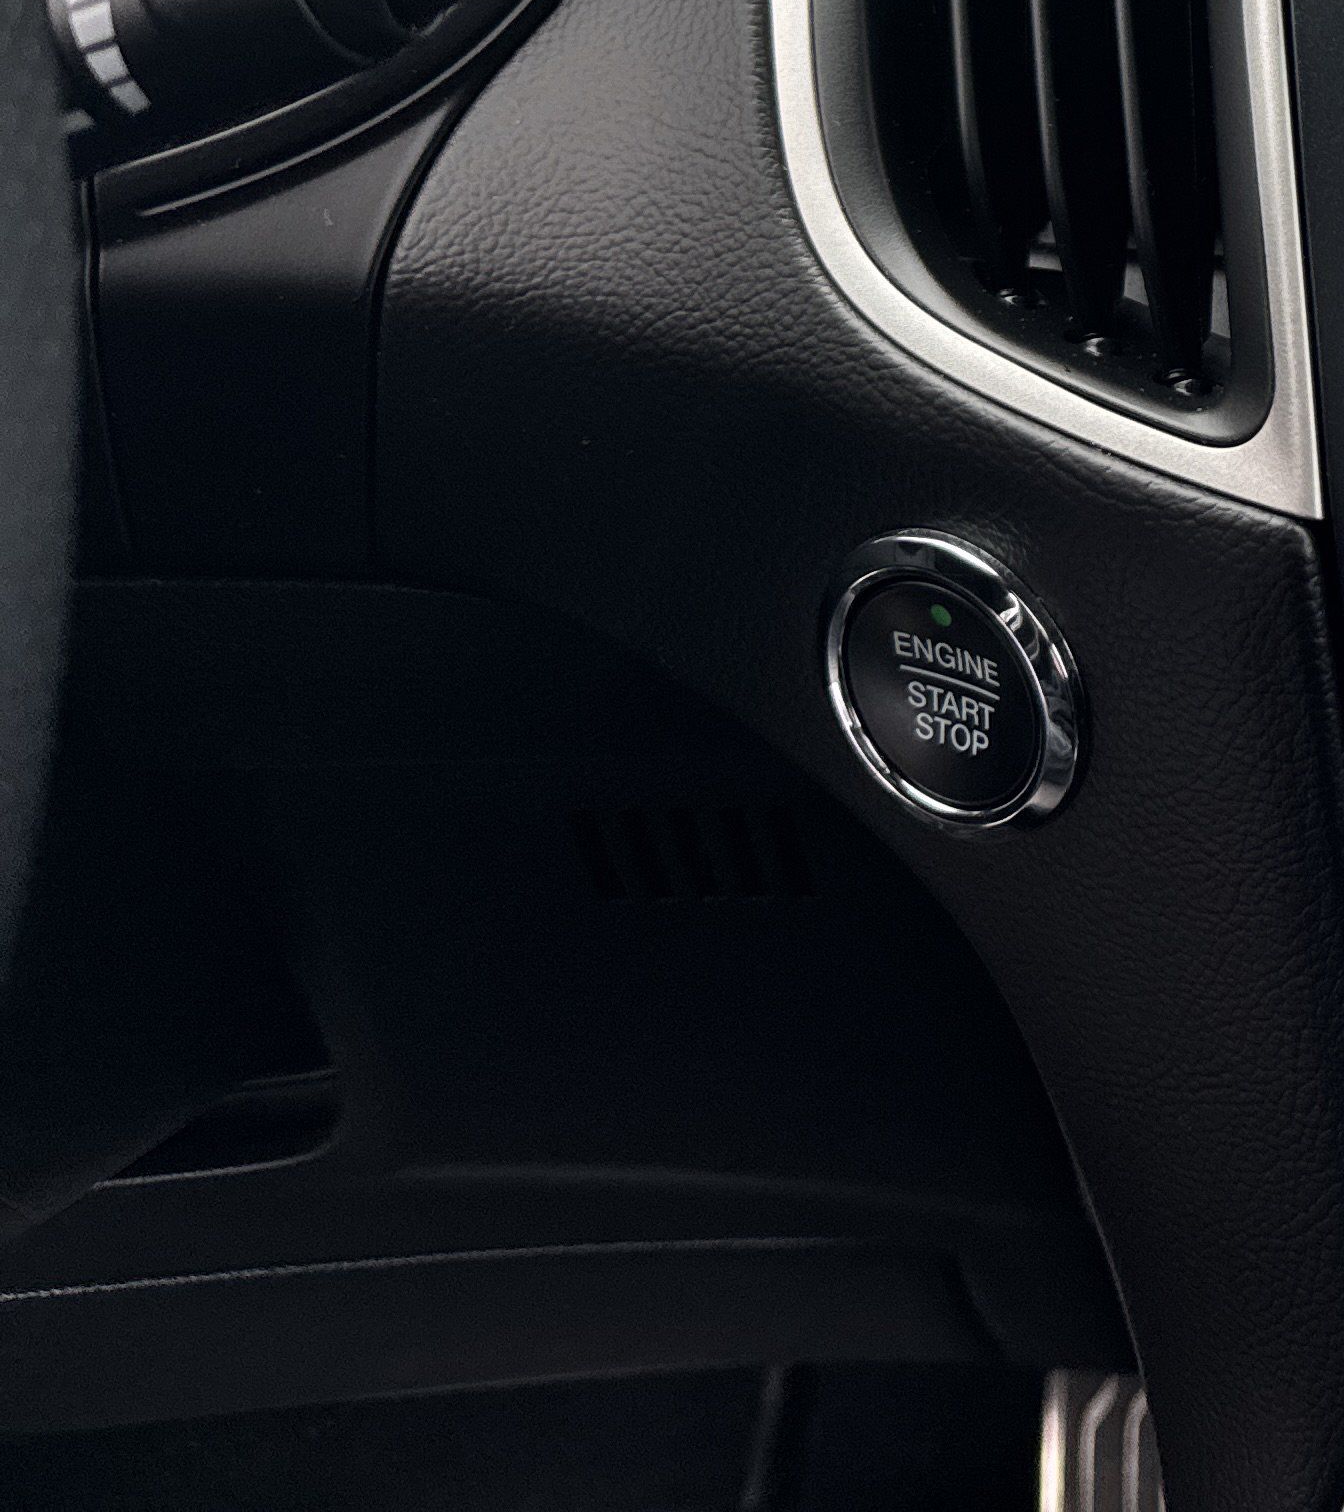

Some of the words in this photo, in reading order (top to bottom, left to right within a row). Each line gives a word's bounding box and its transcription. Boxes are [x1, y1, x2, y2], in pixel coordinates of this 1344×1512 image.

[892, 630, 1001, 688] ENGINE
[907, 681, 995, 731] START
[915, 711, 990, 757] STOP
